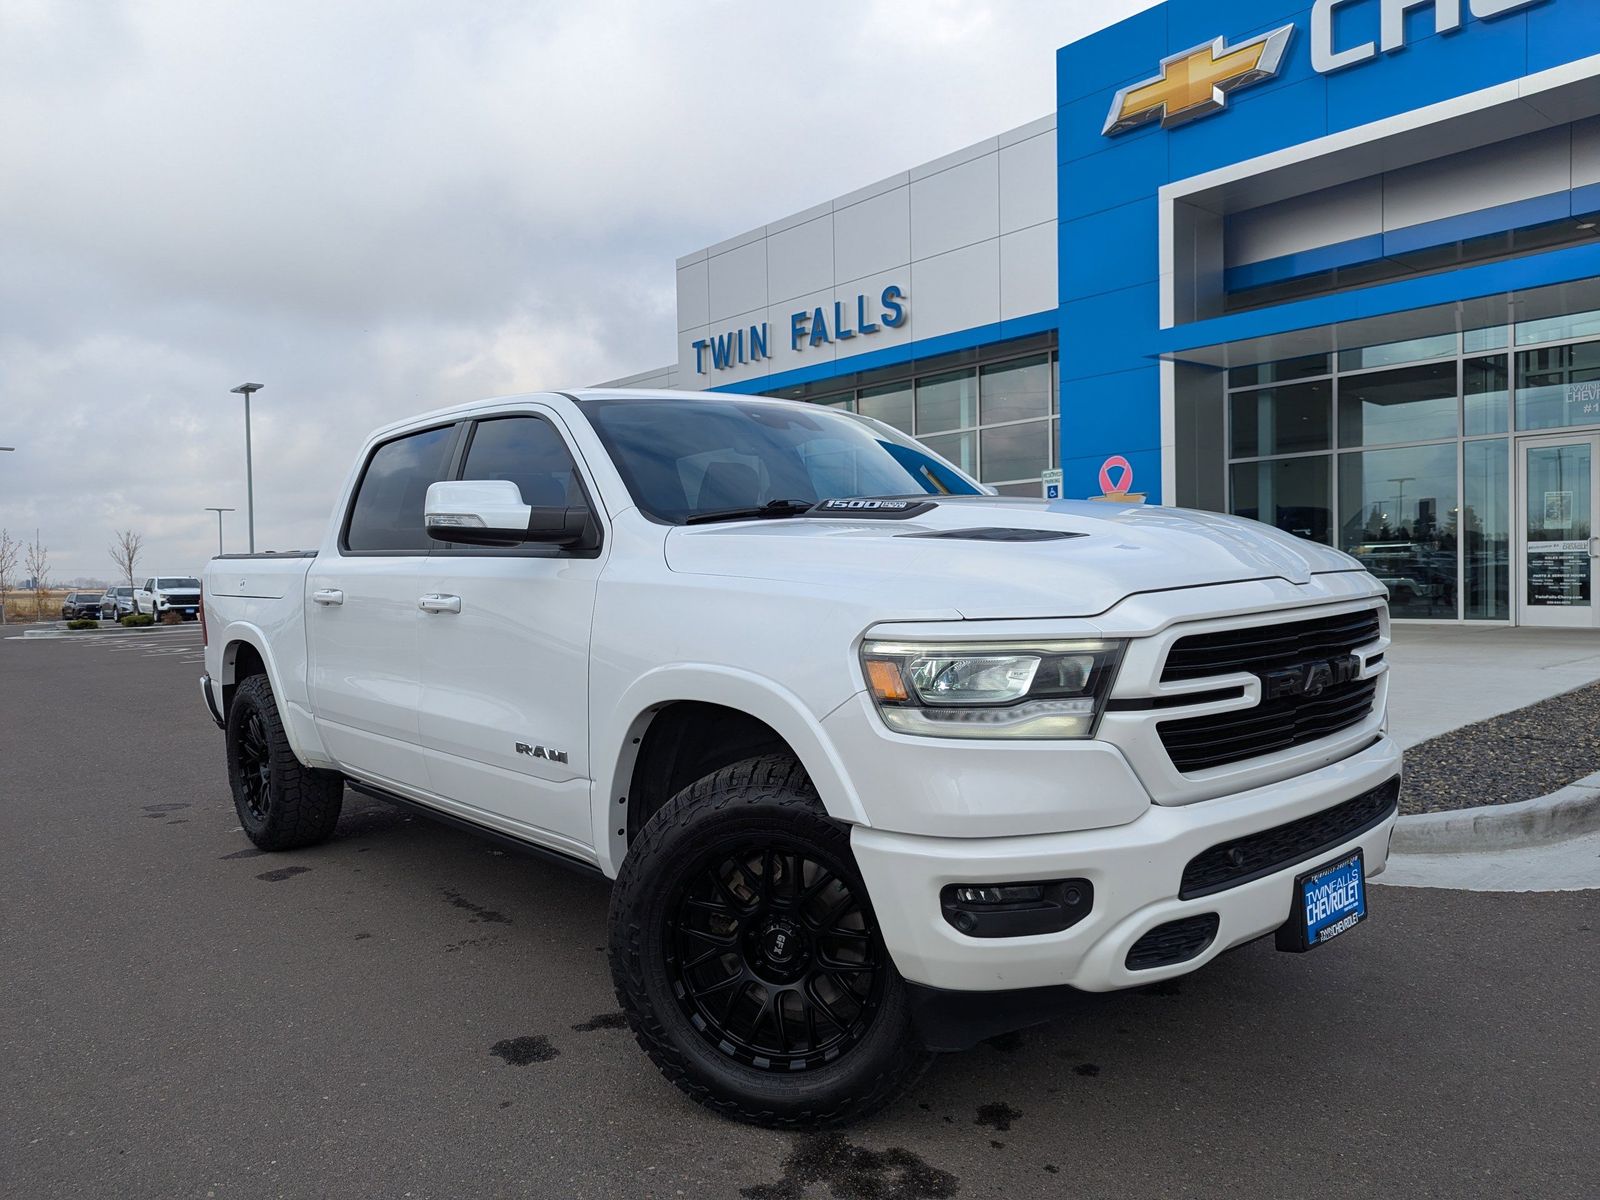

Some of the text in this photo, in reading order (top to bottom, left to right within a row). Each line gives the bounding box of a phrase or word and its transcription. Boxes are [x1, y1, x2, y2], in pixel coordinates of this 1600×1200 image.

[692, 285, 907, 374] TWIN FALLS
[826, 500, 882, 509] 1500
[1266, 655, 1361, 700] RAM
[515, 741, 568, 764] RAM
[1306, 880, 1360, 926] CHEVROLET
[773, 934, 786, 955] GFX
